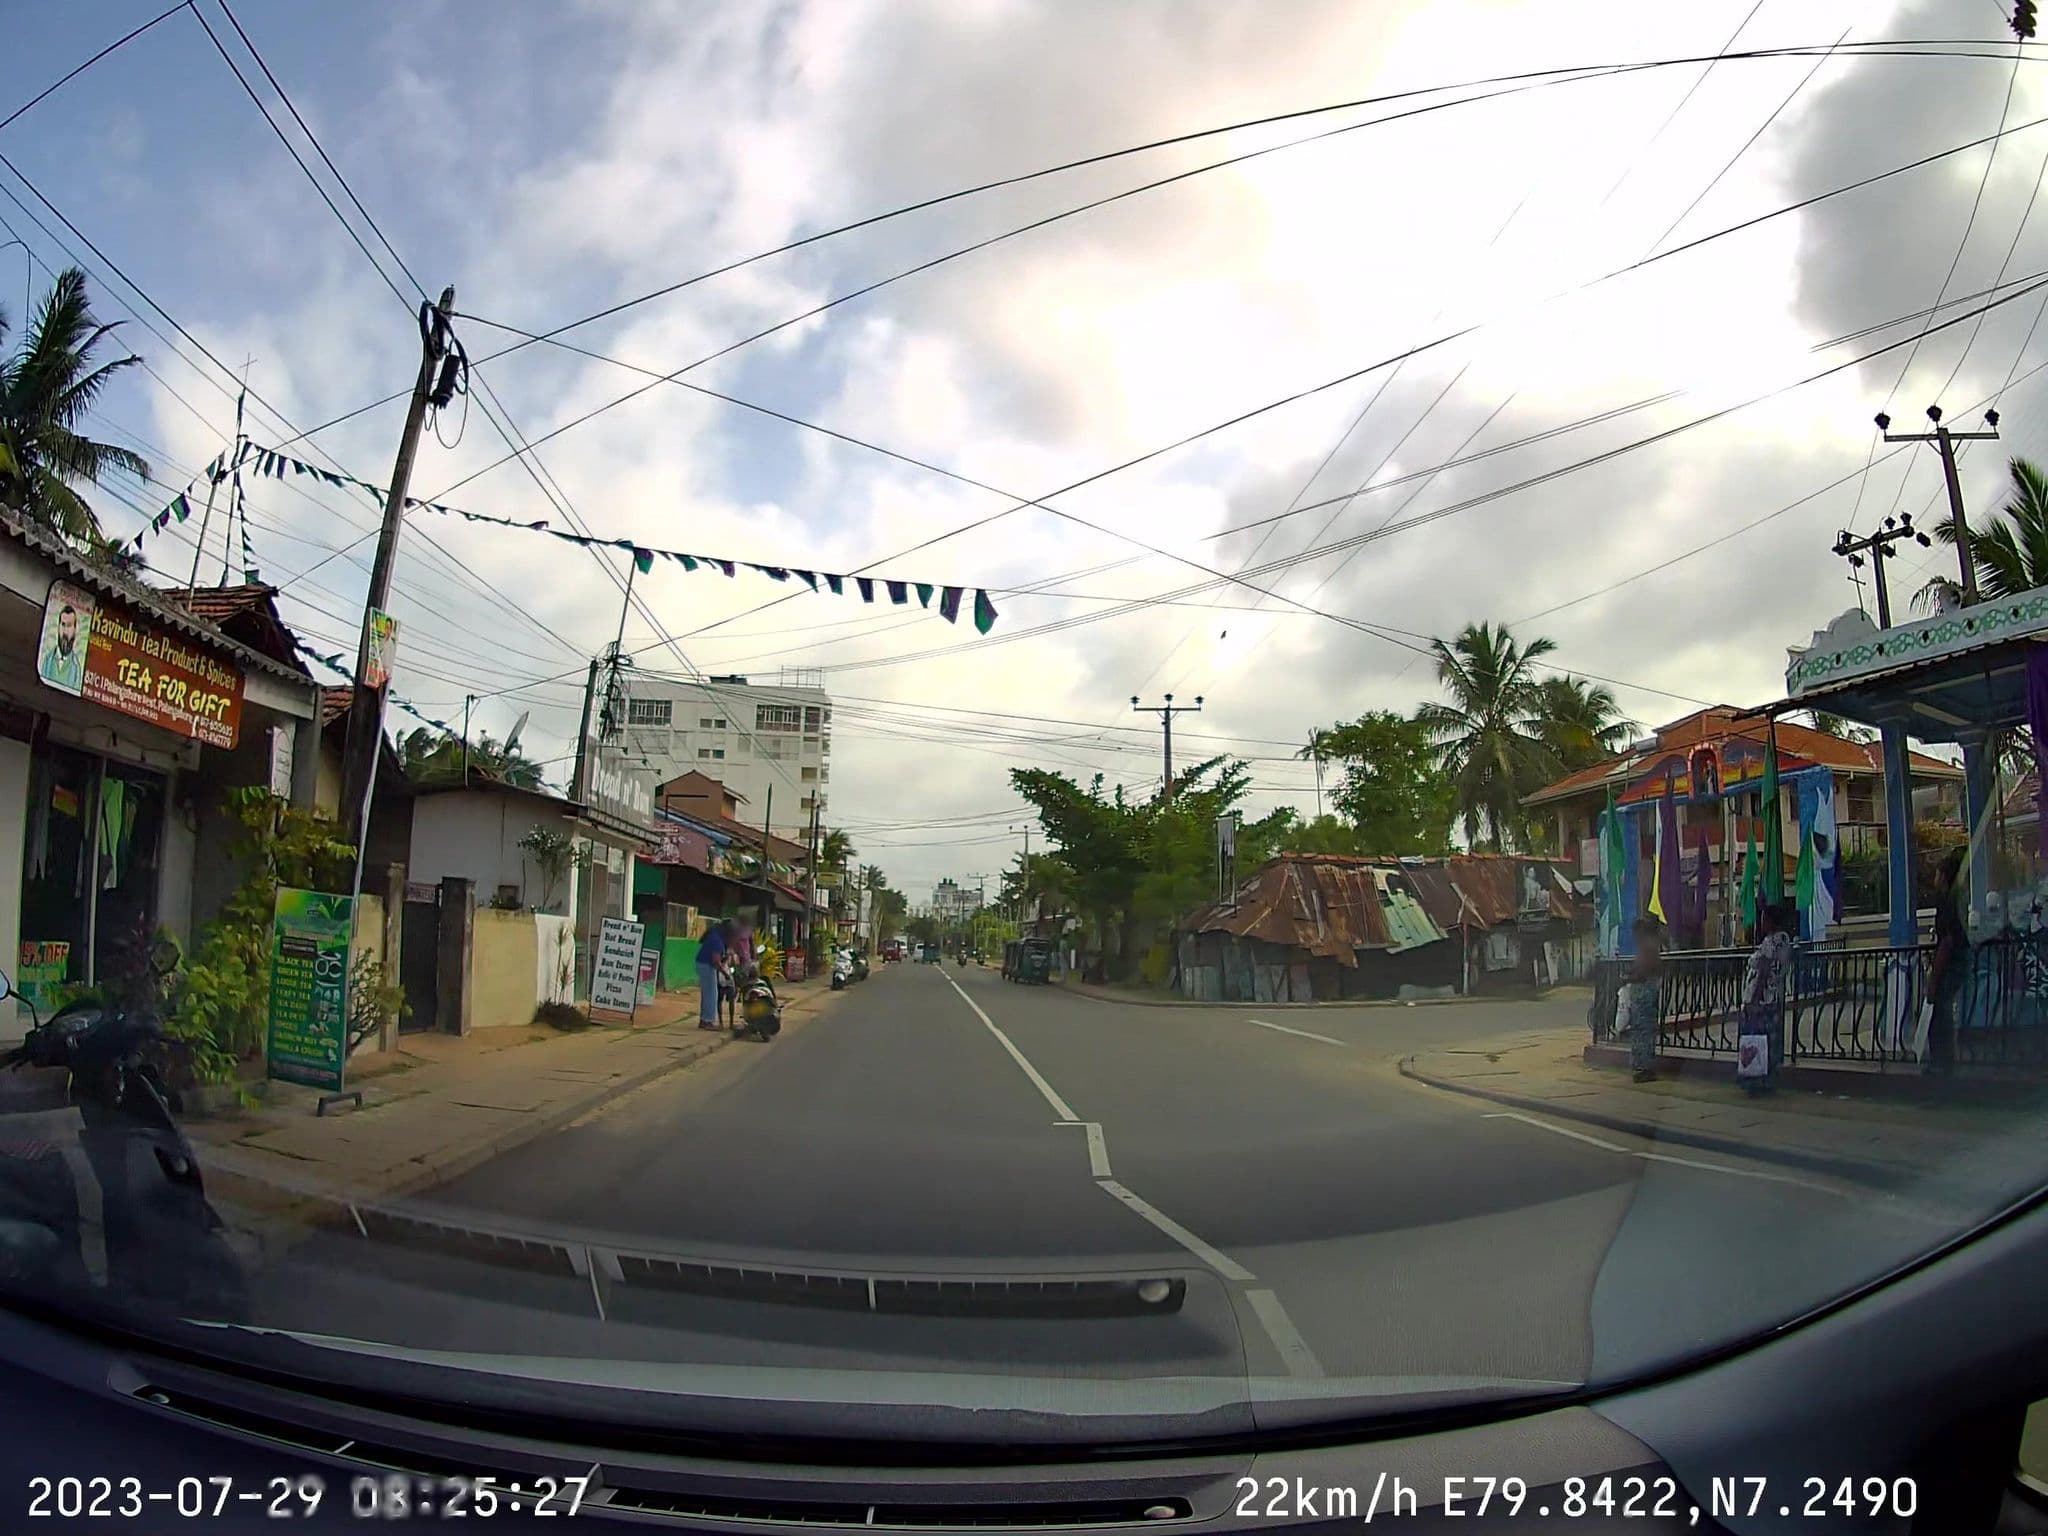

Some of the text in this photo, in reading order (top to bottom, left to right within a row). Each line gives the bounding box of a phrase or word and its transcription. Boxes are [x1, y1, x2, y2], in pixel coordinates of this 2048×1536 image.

[91, 606, 137, 647] Kavindu
[140, 634, 160, 657] Tea
[159, 636, 199, 675] Product
[197, 655, 207, 677] &
[206, 659, 237, 692] Spices
[116, 658, 152, 694] TEA
[157, 675, 186, 708] FOR
[189, 689, 231, 722] GIFT
[46, 943, 68, 964] OFF
